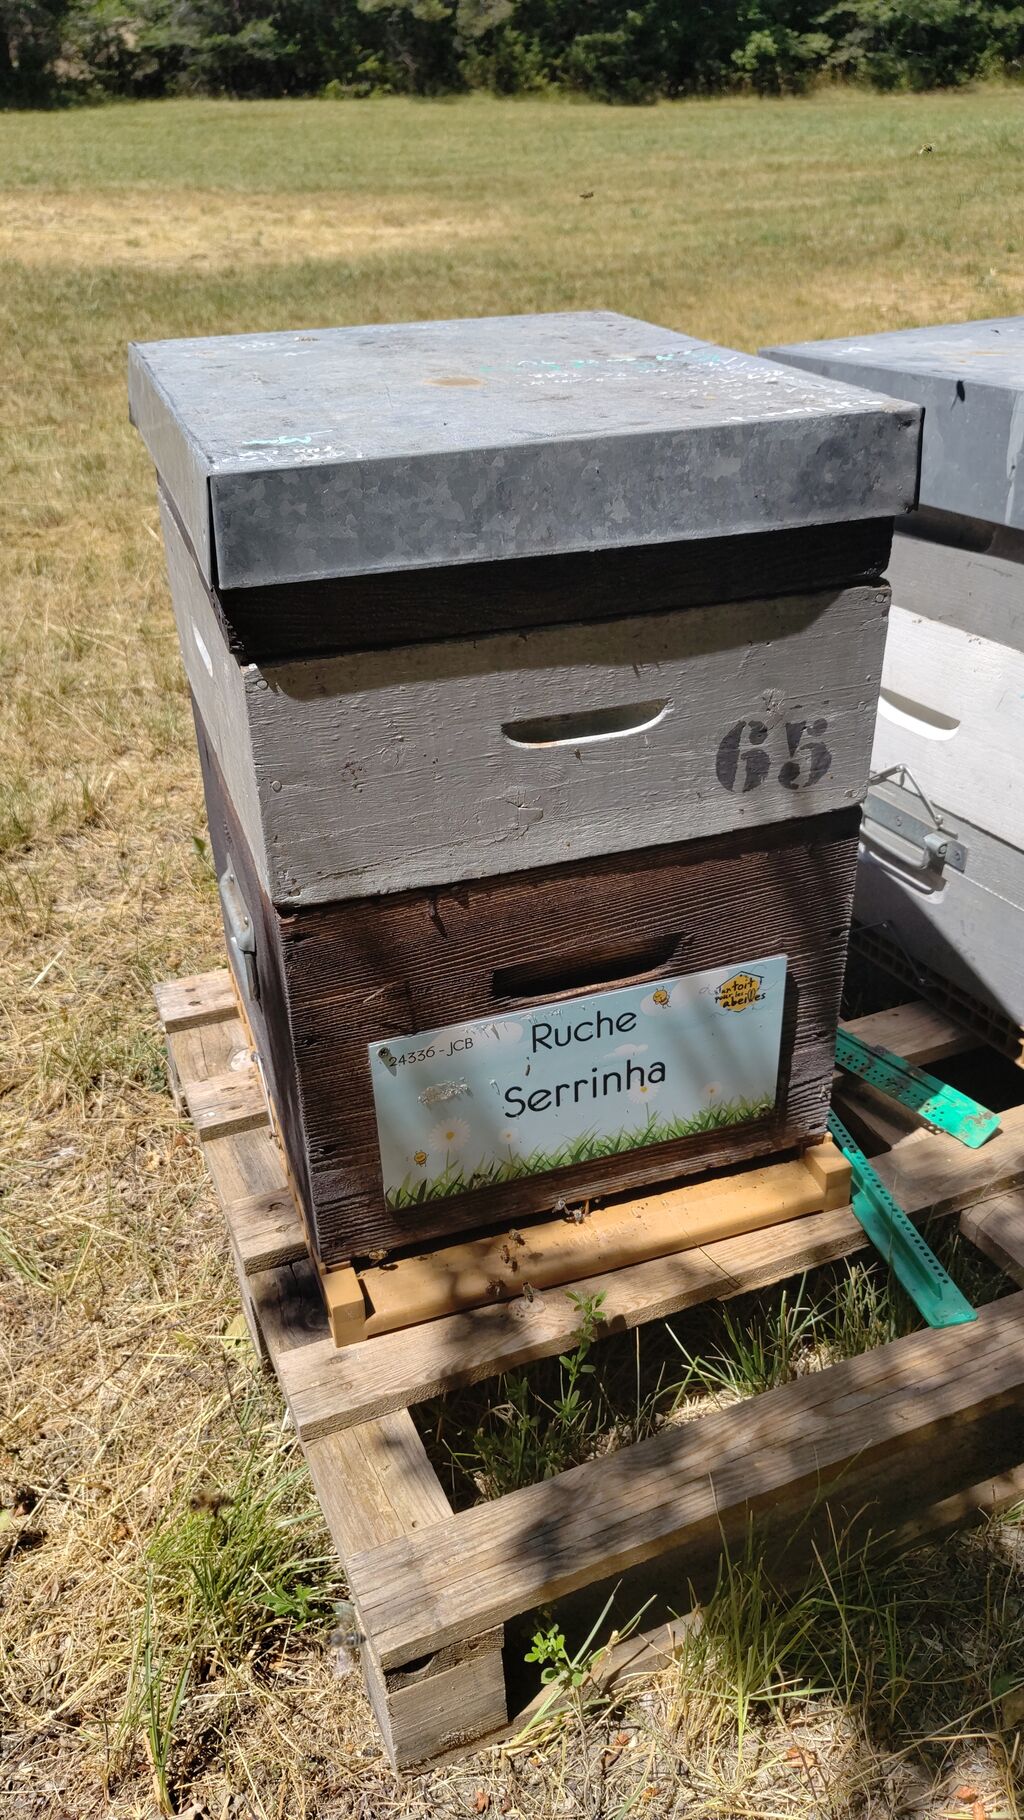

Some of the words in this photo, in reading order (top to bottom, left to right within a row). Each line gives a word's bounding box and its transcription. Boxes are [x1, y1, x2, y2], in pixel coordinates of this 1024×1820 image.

[715, 717, 833, 793] 65
[723, 988, 766, 1008] abeilles
[732, 977, 754, 991] toit
[531, 1010, 637, 1054] Ruche
[504, 1059, 666, 1118] Serrinha
